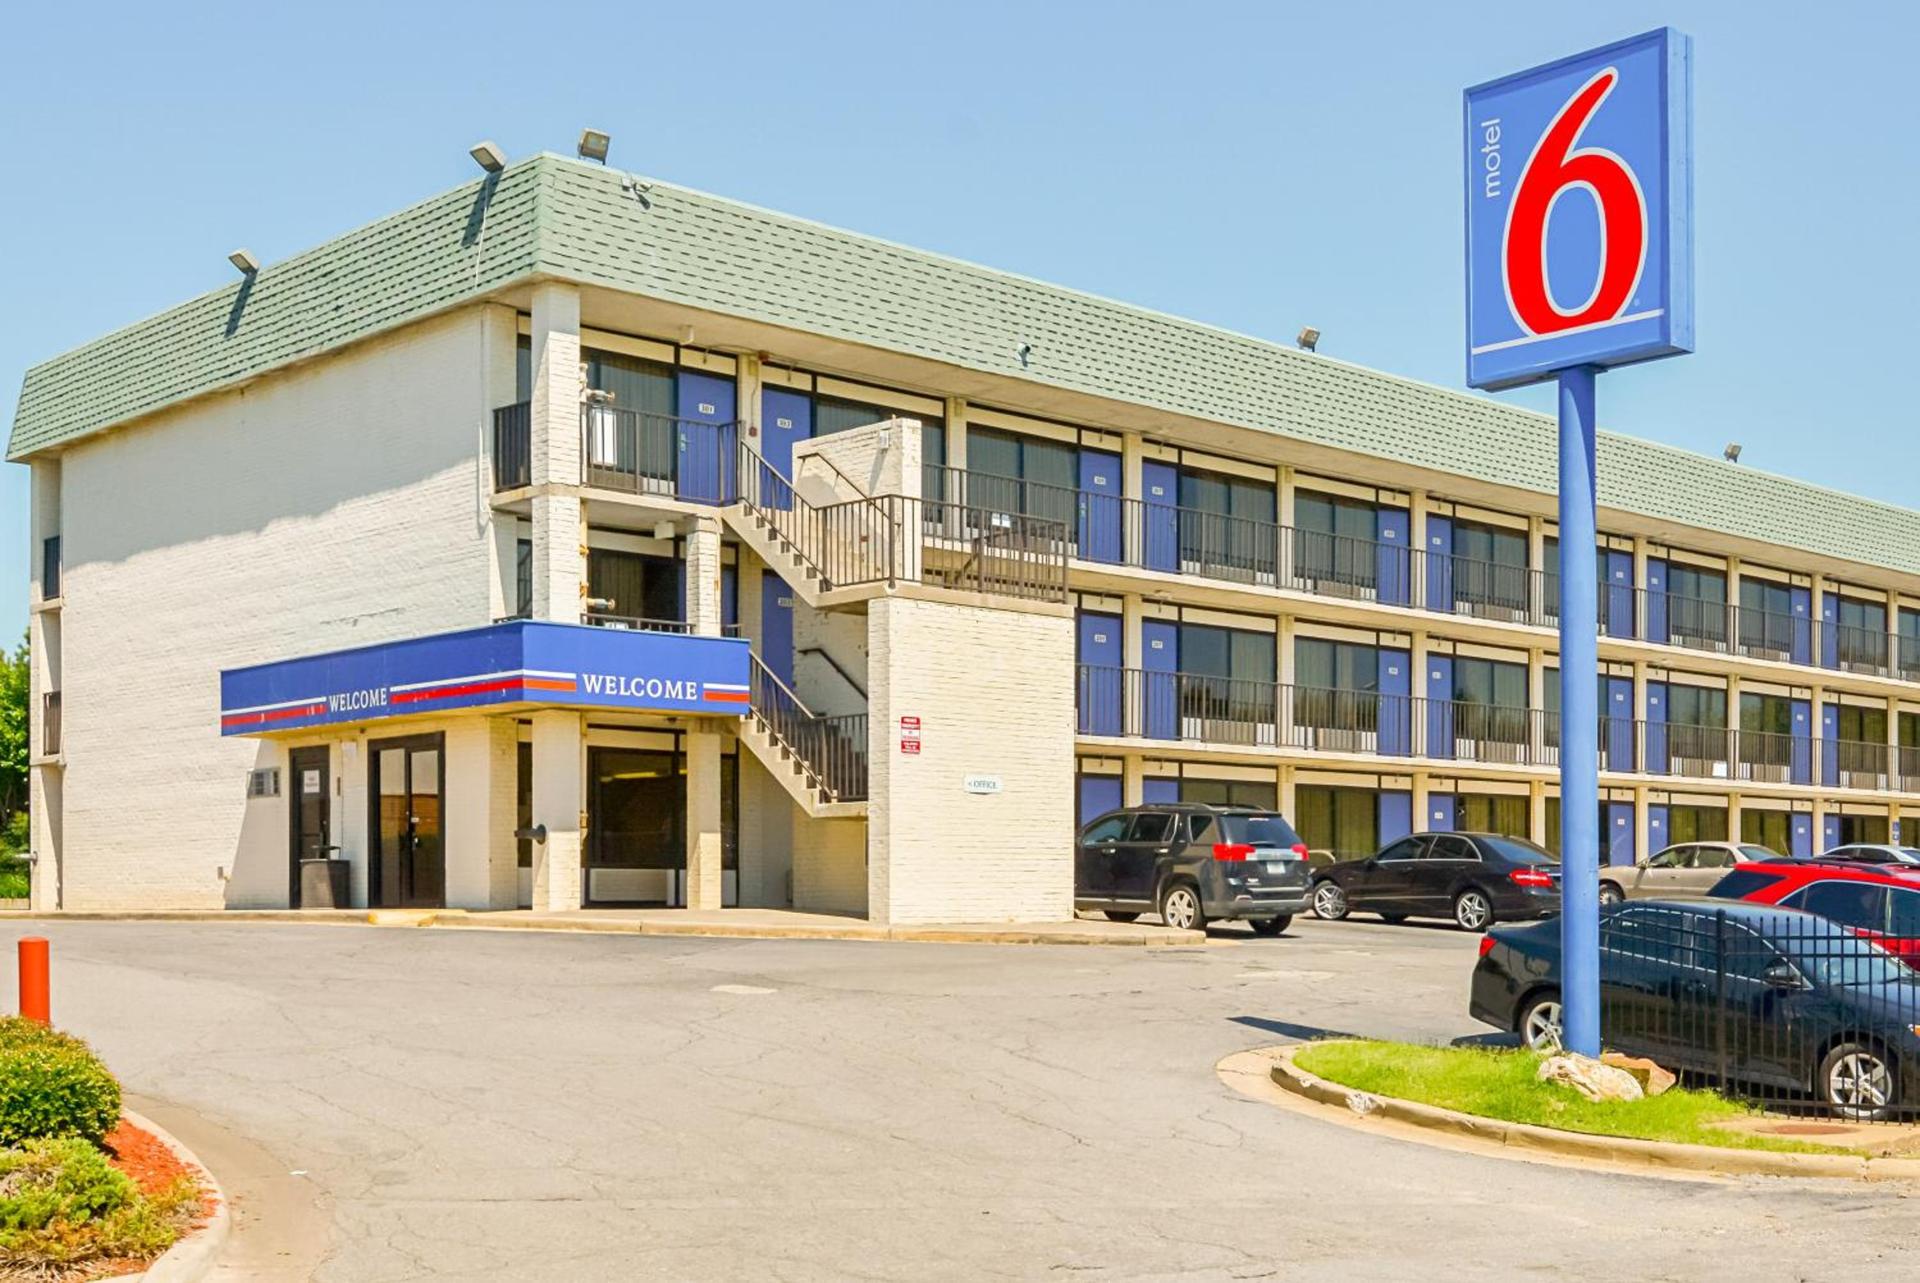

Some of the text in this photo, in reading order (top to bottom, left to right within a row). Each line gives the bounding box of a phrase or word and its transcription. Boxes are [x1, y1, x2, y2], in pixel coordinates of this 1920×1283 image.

[1481, 118, 1501, 198] motel
[1502, 66, 1648, 338] 6
[328, 687, 387, 712] WELCOME
[582, 673, 698, 700] WELCOME
